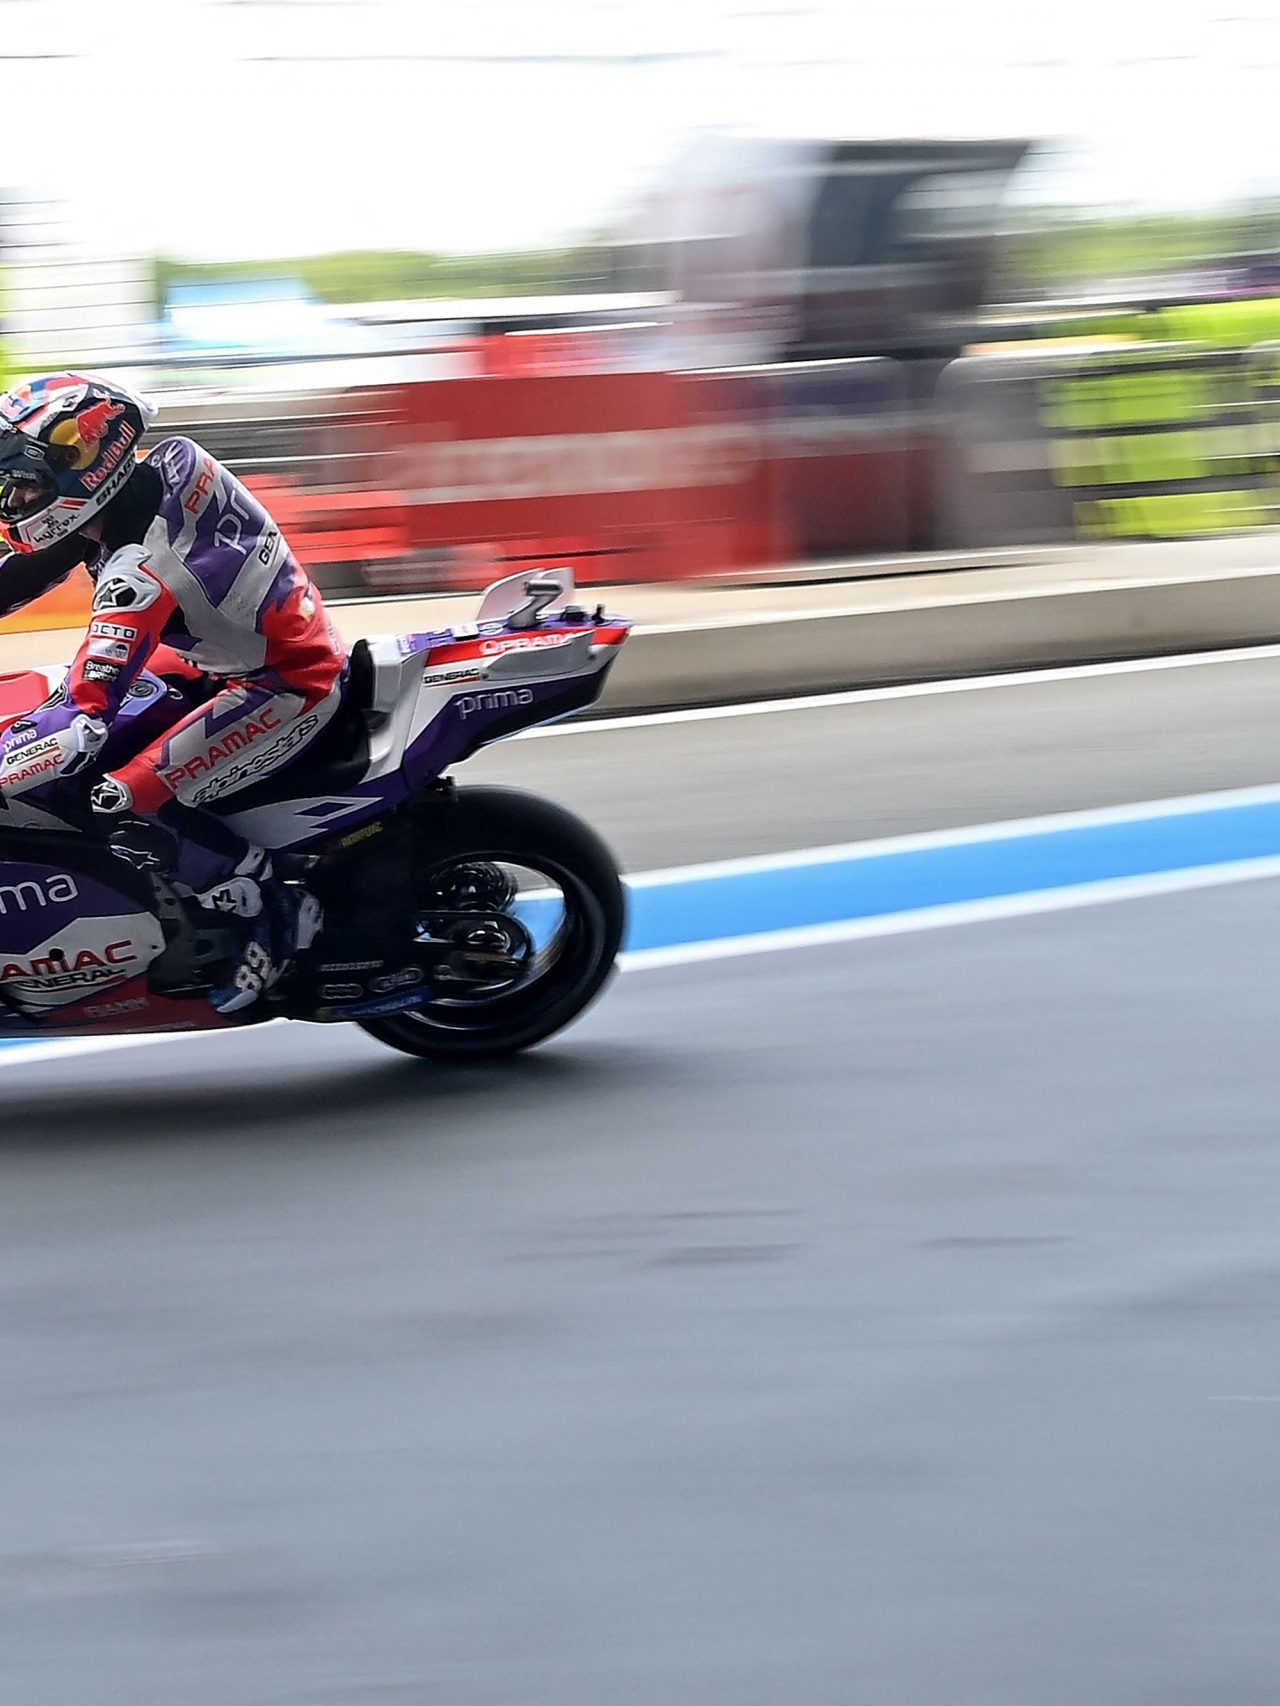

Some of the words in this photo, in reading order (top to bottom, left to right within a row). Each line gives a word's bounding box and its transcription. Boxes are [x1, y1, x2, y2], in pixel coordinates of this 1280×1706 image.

[107, 419, 137, 462] Bull
[454, 688, 535, 721] prima
[3, 728, 38, 753] prima
[6, 738, 59, 766] GENERAC
[165, 708, 282, 790] PRAMAC
